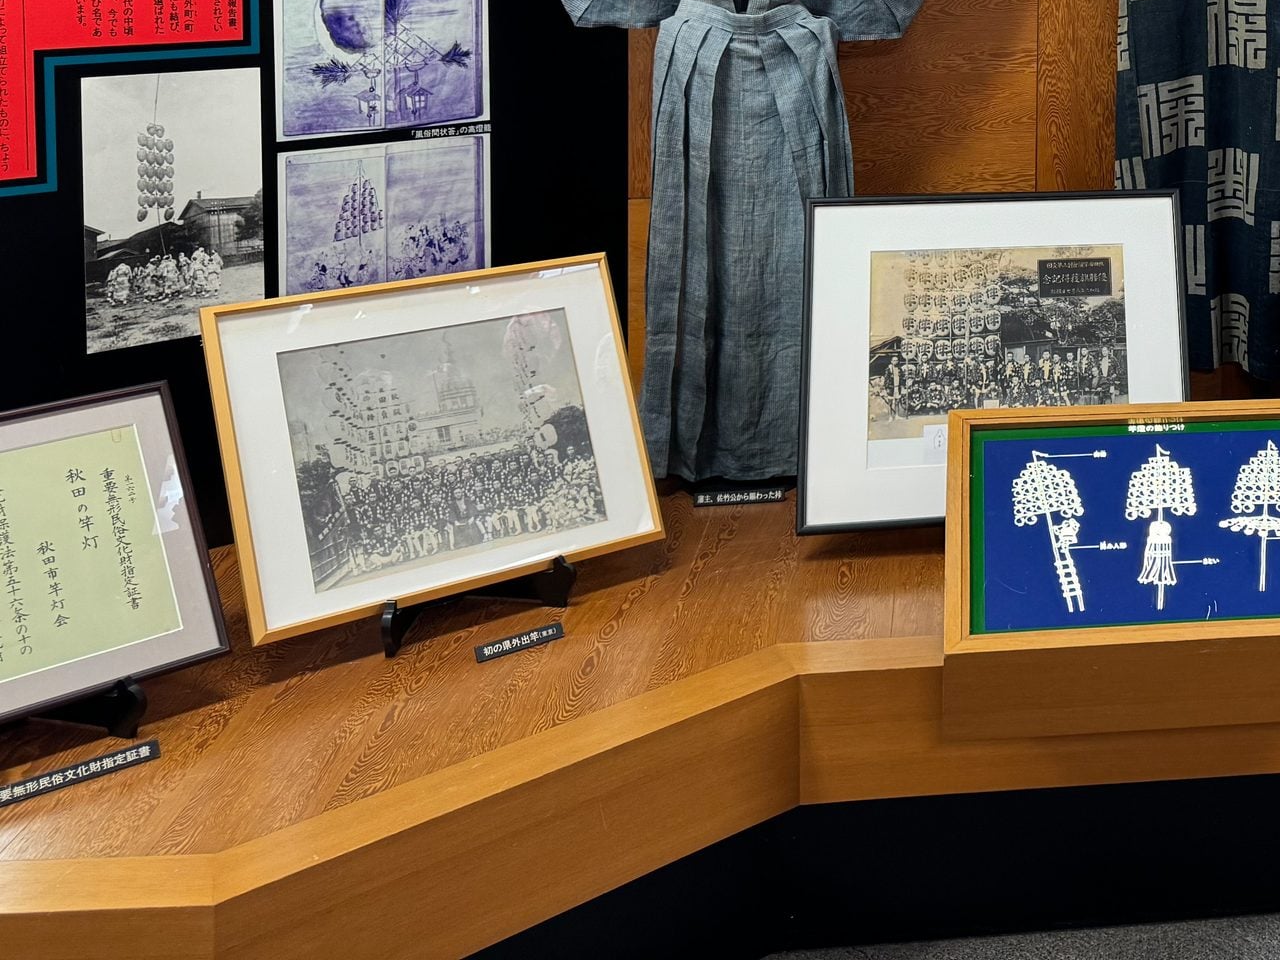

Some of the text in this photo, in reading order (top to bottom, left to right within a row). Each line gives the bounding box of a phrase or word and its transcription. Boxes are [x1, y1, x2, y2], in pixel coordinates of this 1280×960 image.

[66, 468, 99, 551] 秋田の竿灯
[100, 468, 143, 610] 重要無形民俗文化財指定証書
[37, 540, 71, 628] 秋田市竿灯会
[0, 745, 151, 802] 要無形民俗文化財指定証書
